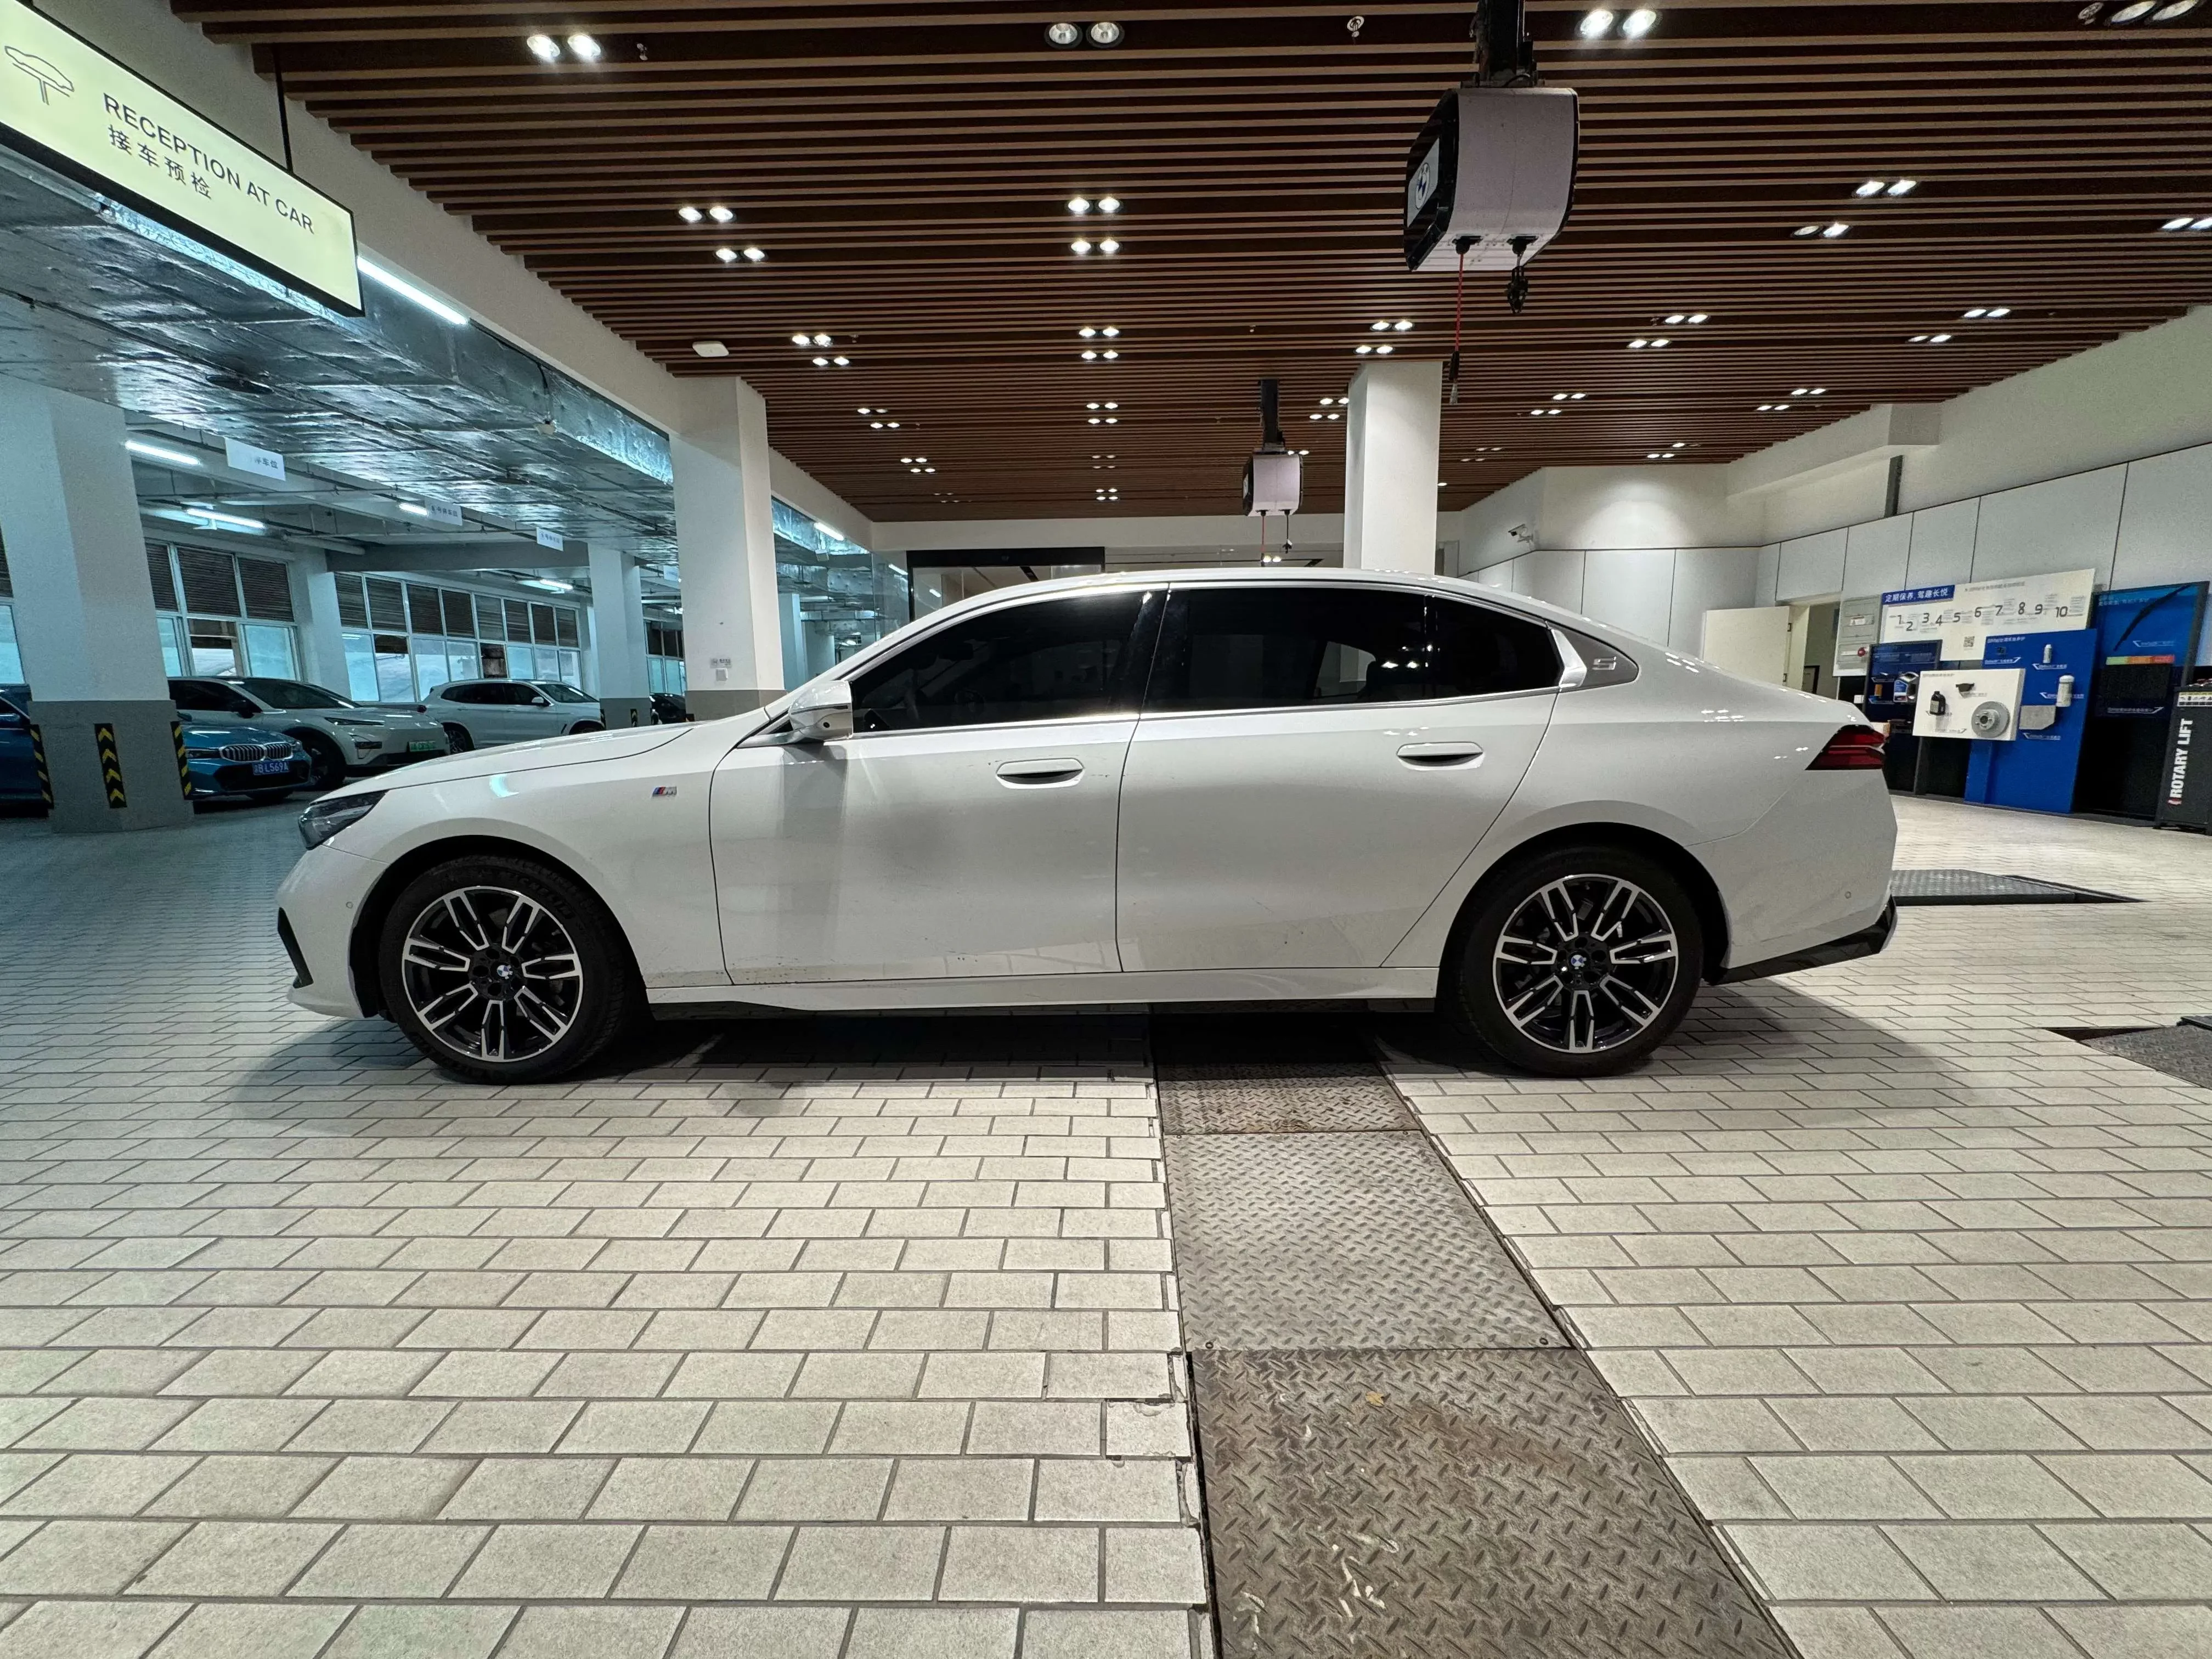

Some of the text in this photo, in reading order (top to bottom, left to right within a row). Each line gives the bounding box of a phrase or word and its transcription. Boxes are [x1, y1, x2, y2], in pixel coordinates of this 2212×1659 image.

[103, 92, 315, 235] RECEPTION AT CAR
[108, 125, 212, 200] 接车预检
[1906, 622, 1913, 631] 2
[1922, 613, 1929, 623] 3
[1936, 615, 1943, 626] 4
[1953, 612, 1962, 623] 5
[1975, 607, 1982, 618] 6
[1995, 605, 2003, 616] 7
[2018, 602, 2025, 614] 8
[2035, 604, 2043, 614] 9
[2056, 606, 2068, 617] 10
[2170, 718, 2193, 798] ROTARY LIFT
